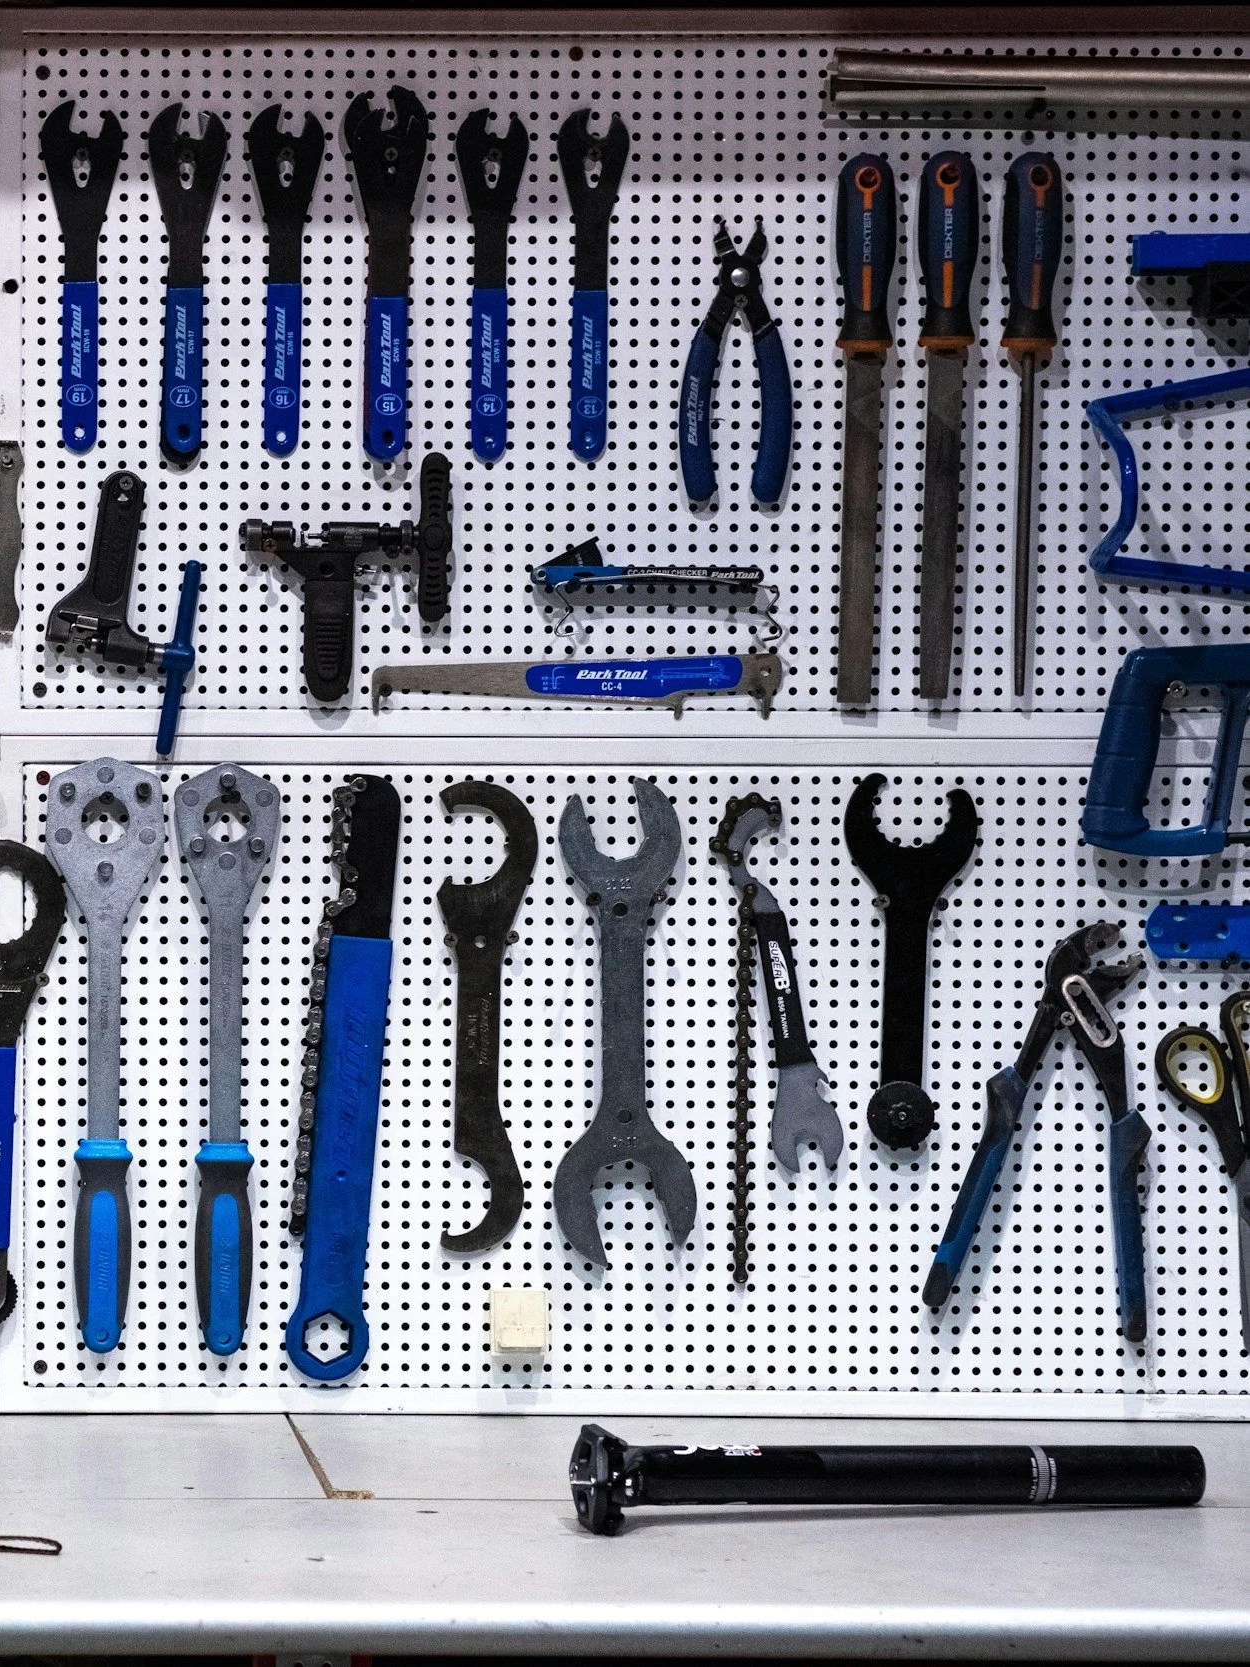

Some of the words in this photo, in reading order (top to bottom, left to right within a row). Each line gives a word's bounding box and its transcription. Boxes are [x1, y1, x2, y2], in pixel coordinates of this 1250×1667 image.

[863, 211, 872, 263] DEXTER
[944, 207, 953, 259] DEXTER
[71, 304, 82, 342] Tool
[175, 305, 186, 344] Tool
[275, 306, 286, 344] Tool
[380, 313, 392, 351] Tool
[481, 313, 492, 352] Tool
[582, 315, 594, 353] Tool
[71, 342, 82, 379] Park
[187, 330, 195, 355] SCW-17
[175, 344, 185, 380] Park
[274, 345, 285, 381] Park
[380, 352, 391, 388] Park
[481, 352, 492, 389] Park
[582, 354, 593, 390] Park
[72, 392, 87, 403] 19
[176, 393, 190, 404] 17
[276, 394, 289, 405] 16
[382, 401, 396, 412] 15
[483, 402, 496, 413] 14
[583, 403, 597, 414] 13
[687, 375, 699, 409] Tool
[687, 410, 698, 447] Park
[671, 569, 708, 577] CHECKER
[710, 571, 736, 579] Park
[735, 571, 760, 579] Tool
[576, 669, 613, 680] Park
[614, 669, 648, 680] Tool
[601, 682, 623, 691] CC-4
[769, 941, 782, 978] SUPER
[774, 977, 790, 990] B
[780, 1012, 790, 1039] TAIWAN
